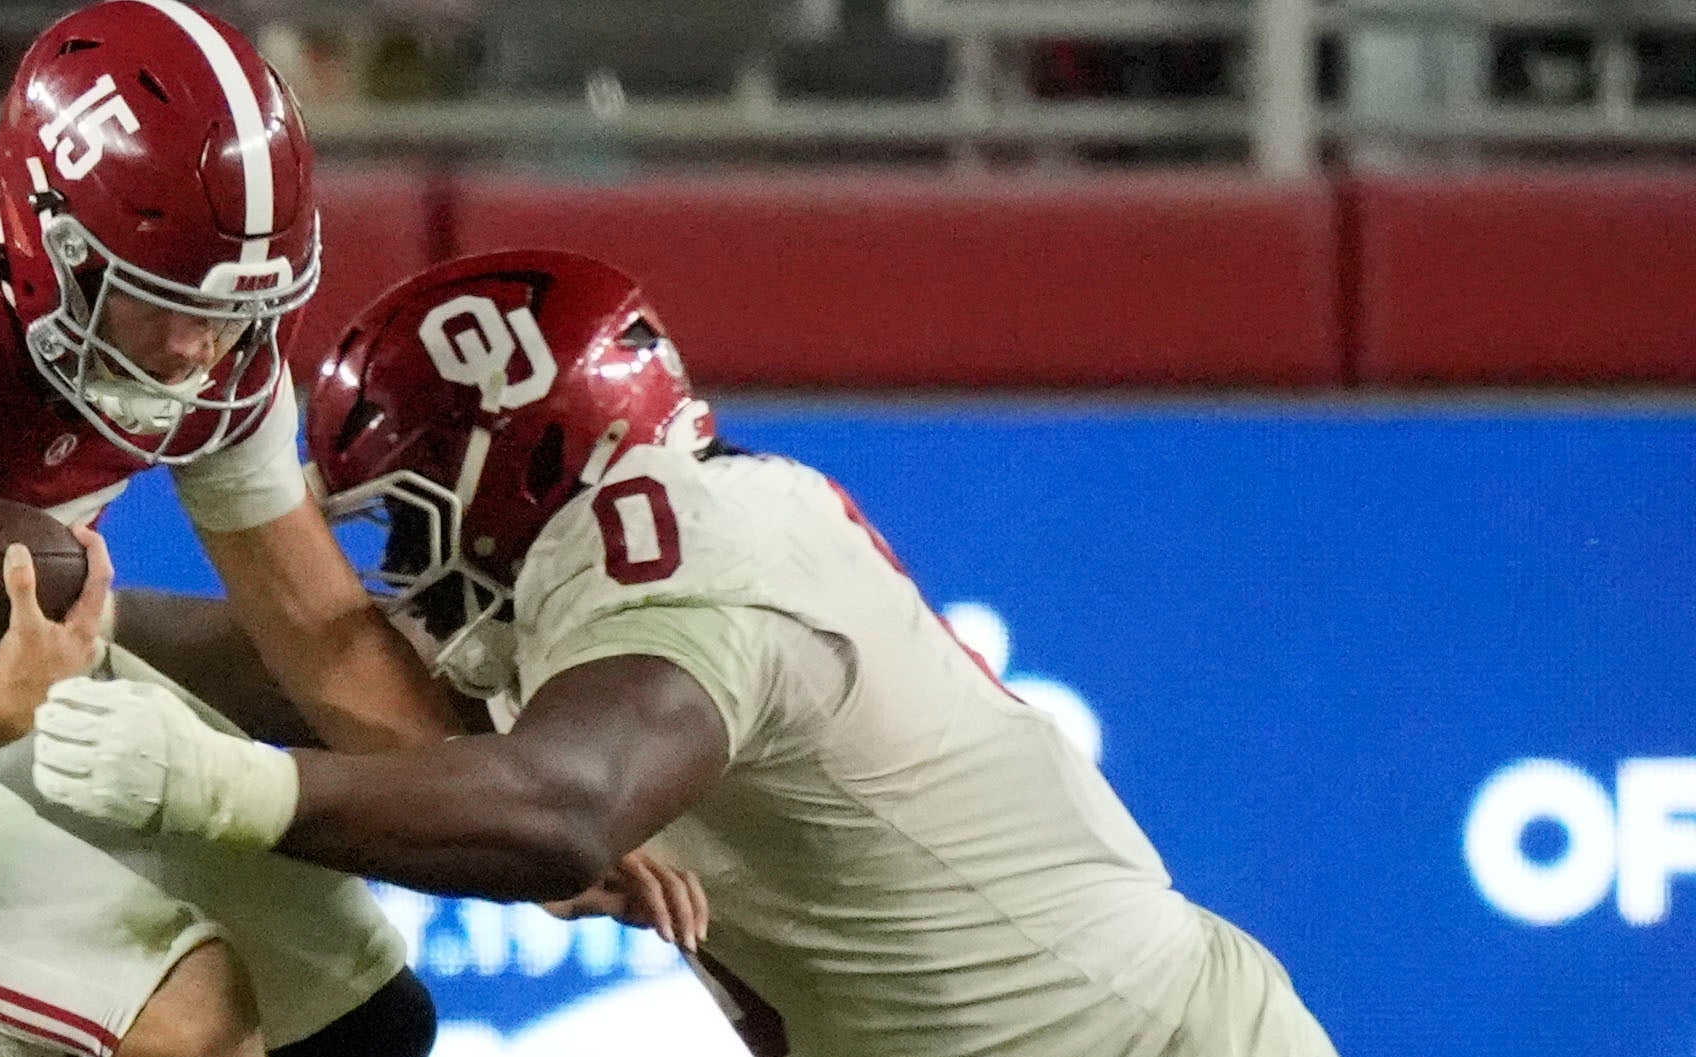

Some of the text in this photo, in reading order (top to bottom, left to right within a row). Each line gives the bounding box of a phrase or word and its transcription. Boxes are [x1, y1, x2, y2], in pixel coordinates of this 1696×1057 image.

[38, 73, 141, 181] 15
[418, 294, 558, 414] OU
[592, 475, 682, 587] 0
